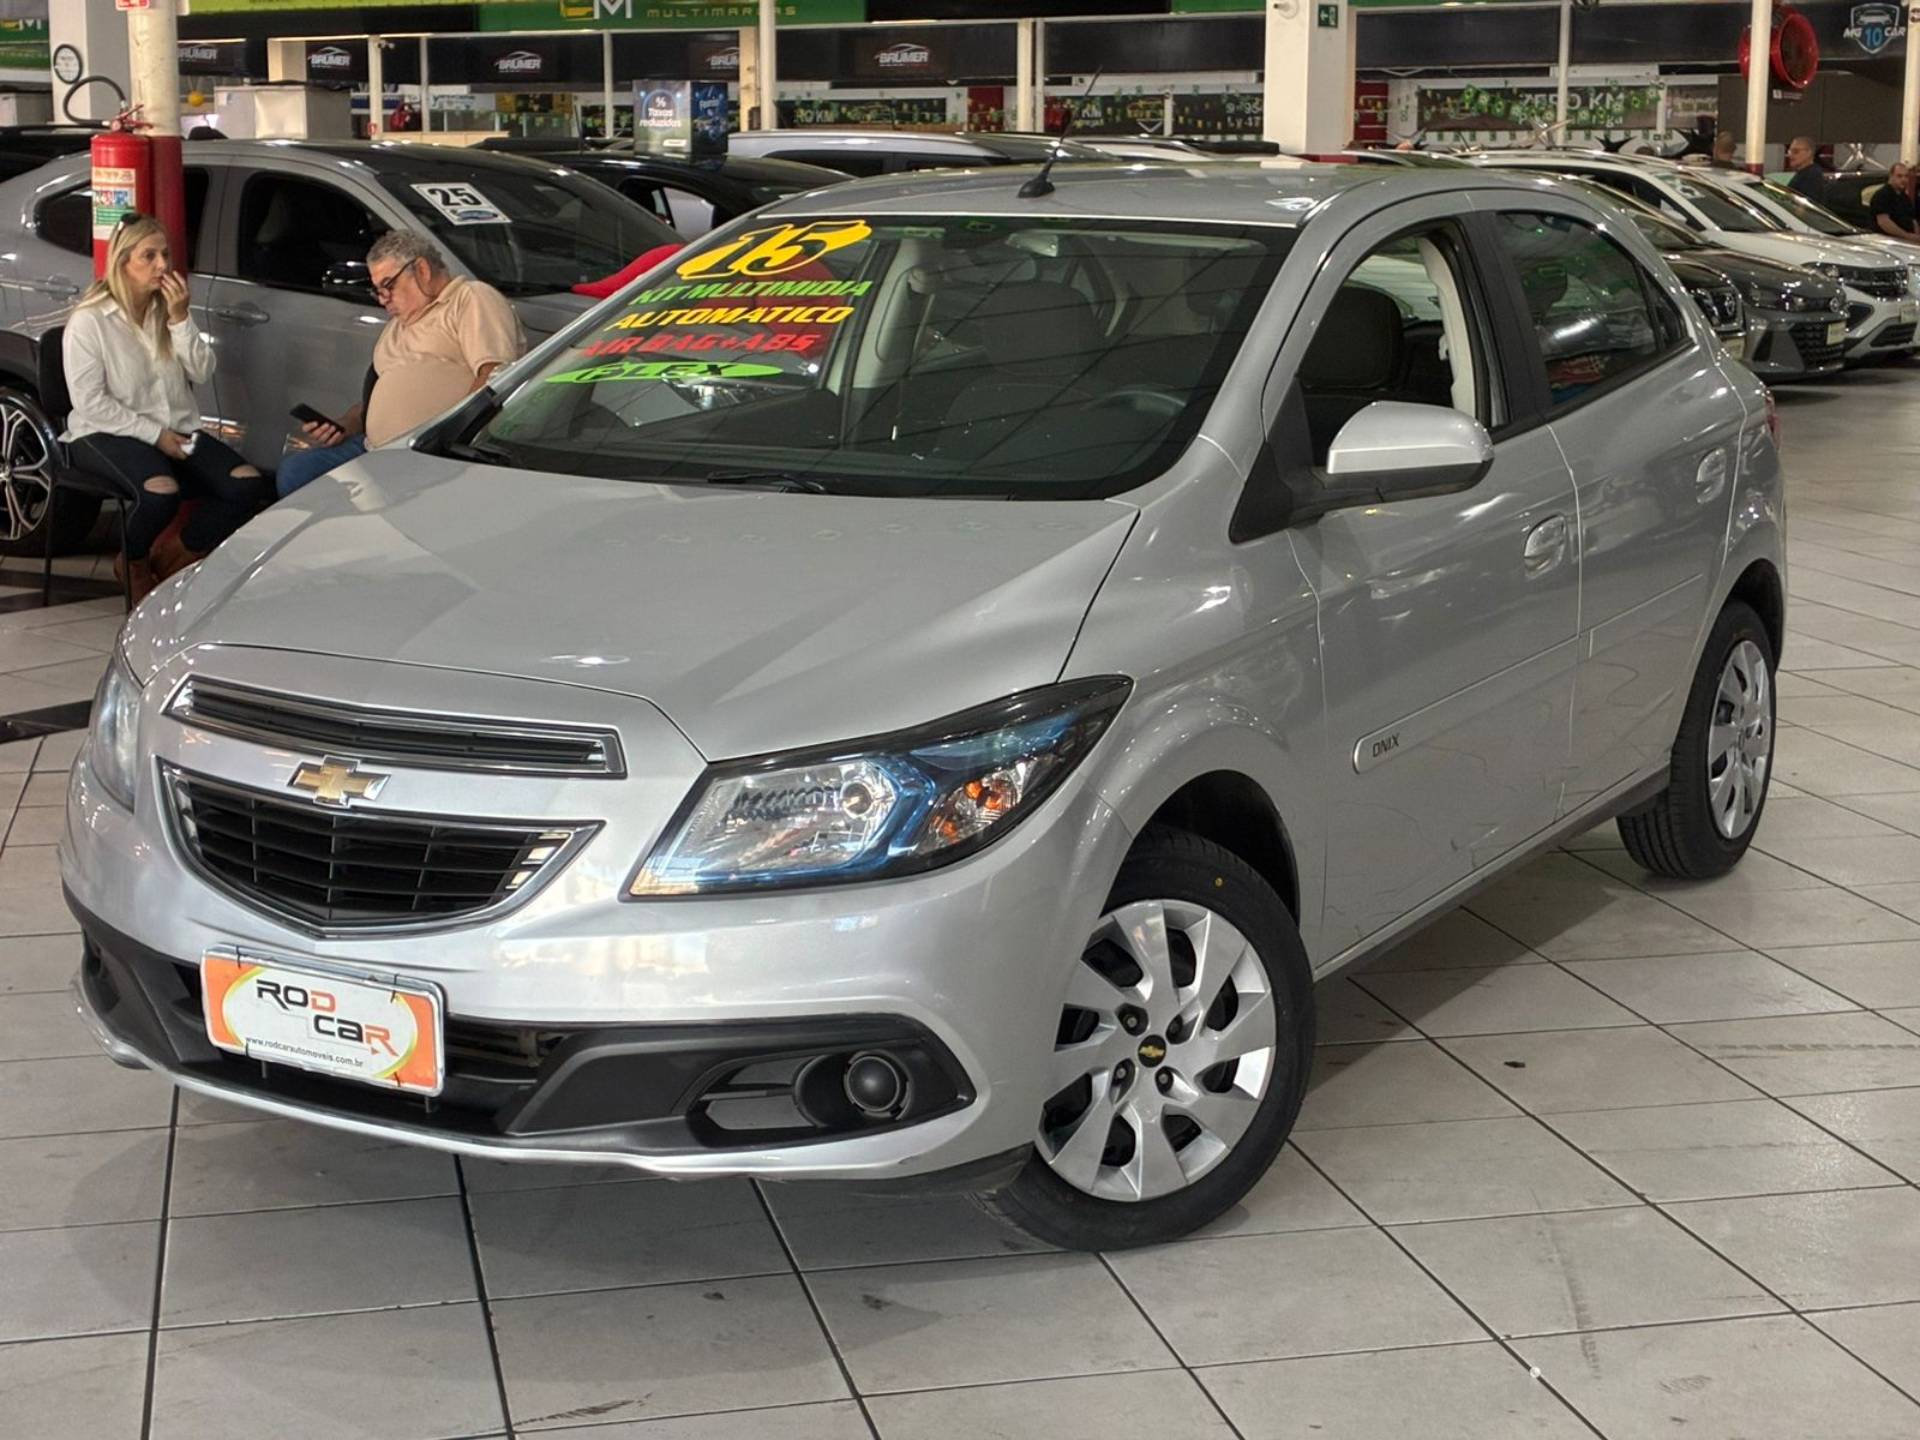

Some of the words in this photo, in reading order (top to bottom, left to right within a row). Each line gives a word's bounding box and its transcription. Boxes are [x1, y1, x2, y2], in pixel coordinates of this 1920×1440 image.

[647, 6, 796, 18] MULTIMARAS
[1865, 28, 1882, 47] 10
[1884, 26, 1906, 37] CAR
[427, 187, 482, 207] 25
[680, 280, 873, 299] MULTIMIDIA
[603, 306, 855, 331] AUTOMATICO
[1372, 732, 1400, 758] ONIX
[245, 1037, 365, 1068] www.rodcarautomoveis.com.br
